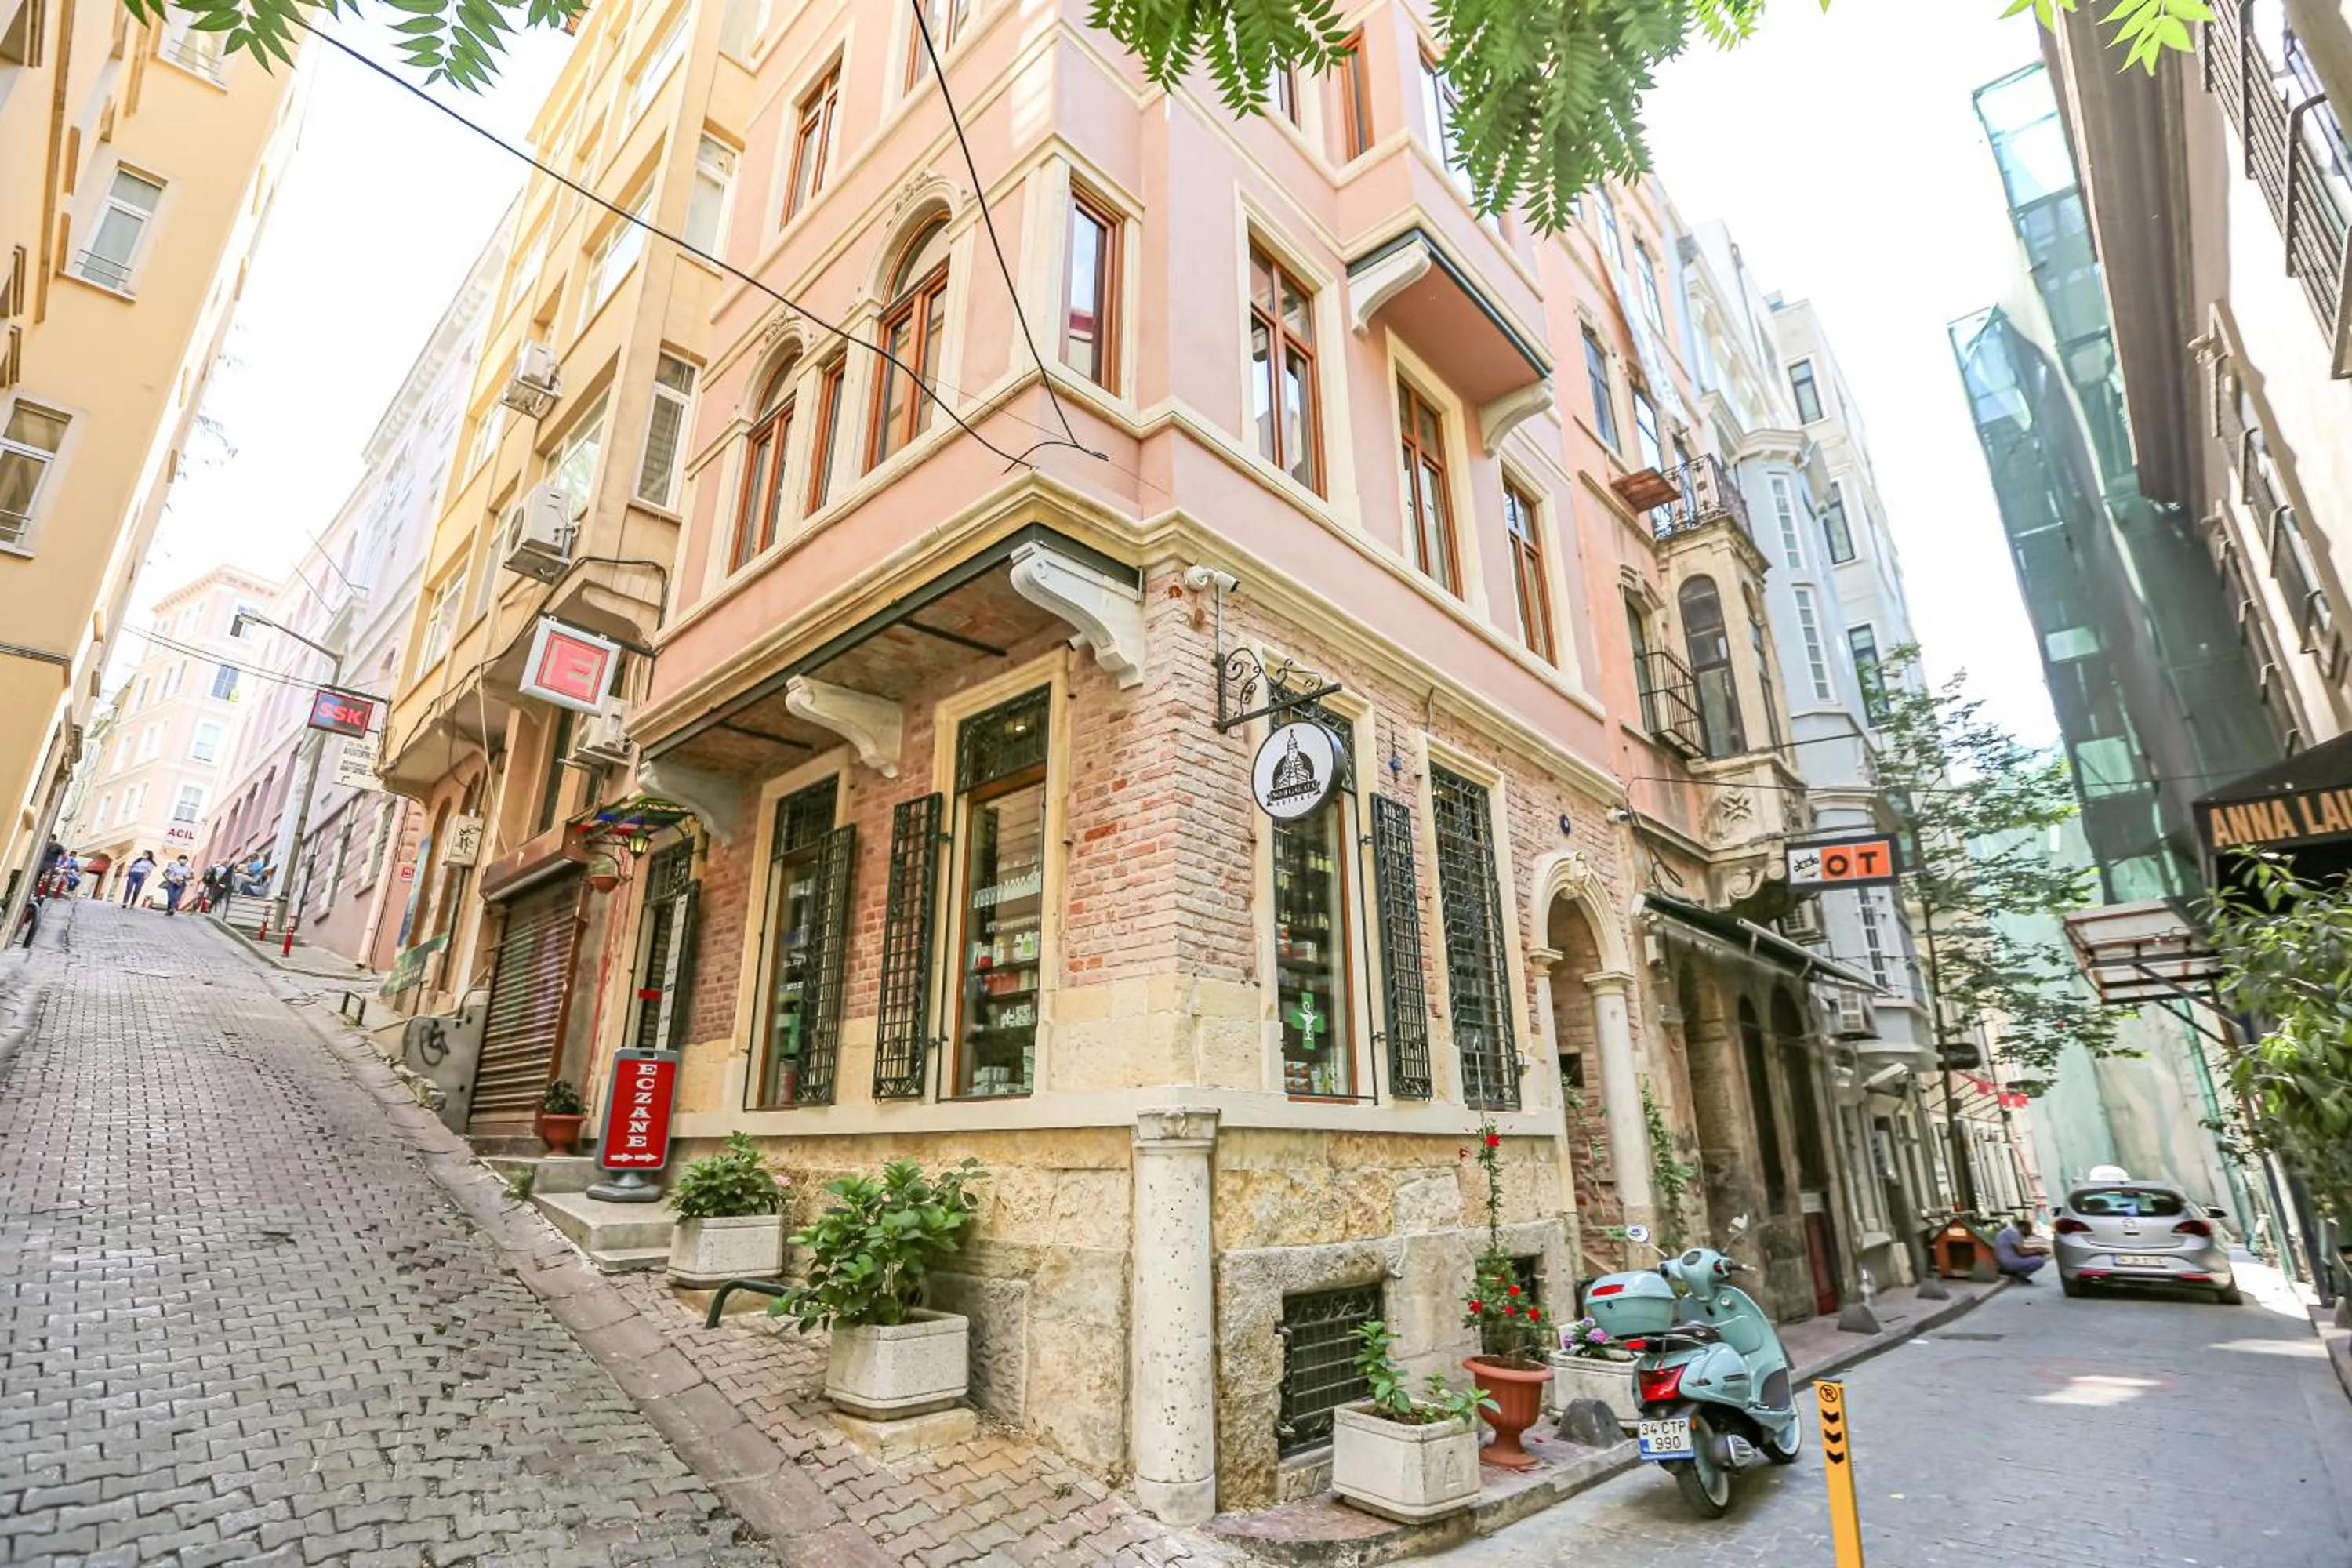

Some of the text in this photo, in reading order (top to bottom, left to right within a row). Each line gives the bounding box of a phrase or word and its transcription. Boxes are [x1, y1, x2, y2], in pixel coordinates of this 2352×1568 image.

[2209, 799, 2299, 848] ANNA
[626, 1063, 658, 1148] ECZANE
[1642, 1420, 1686, 1436] 34 CTP
[1655, 1436, 1682, 1450] 990
